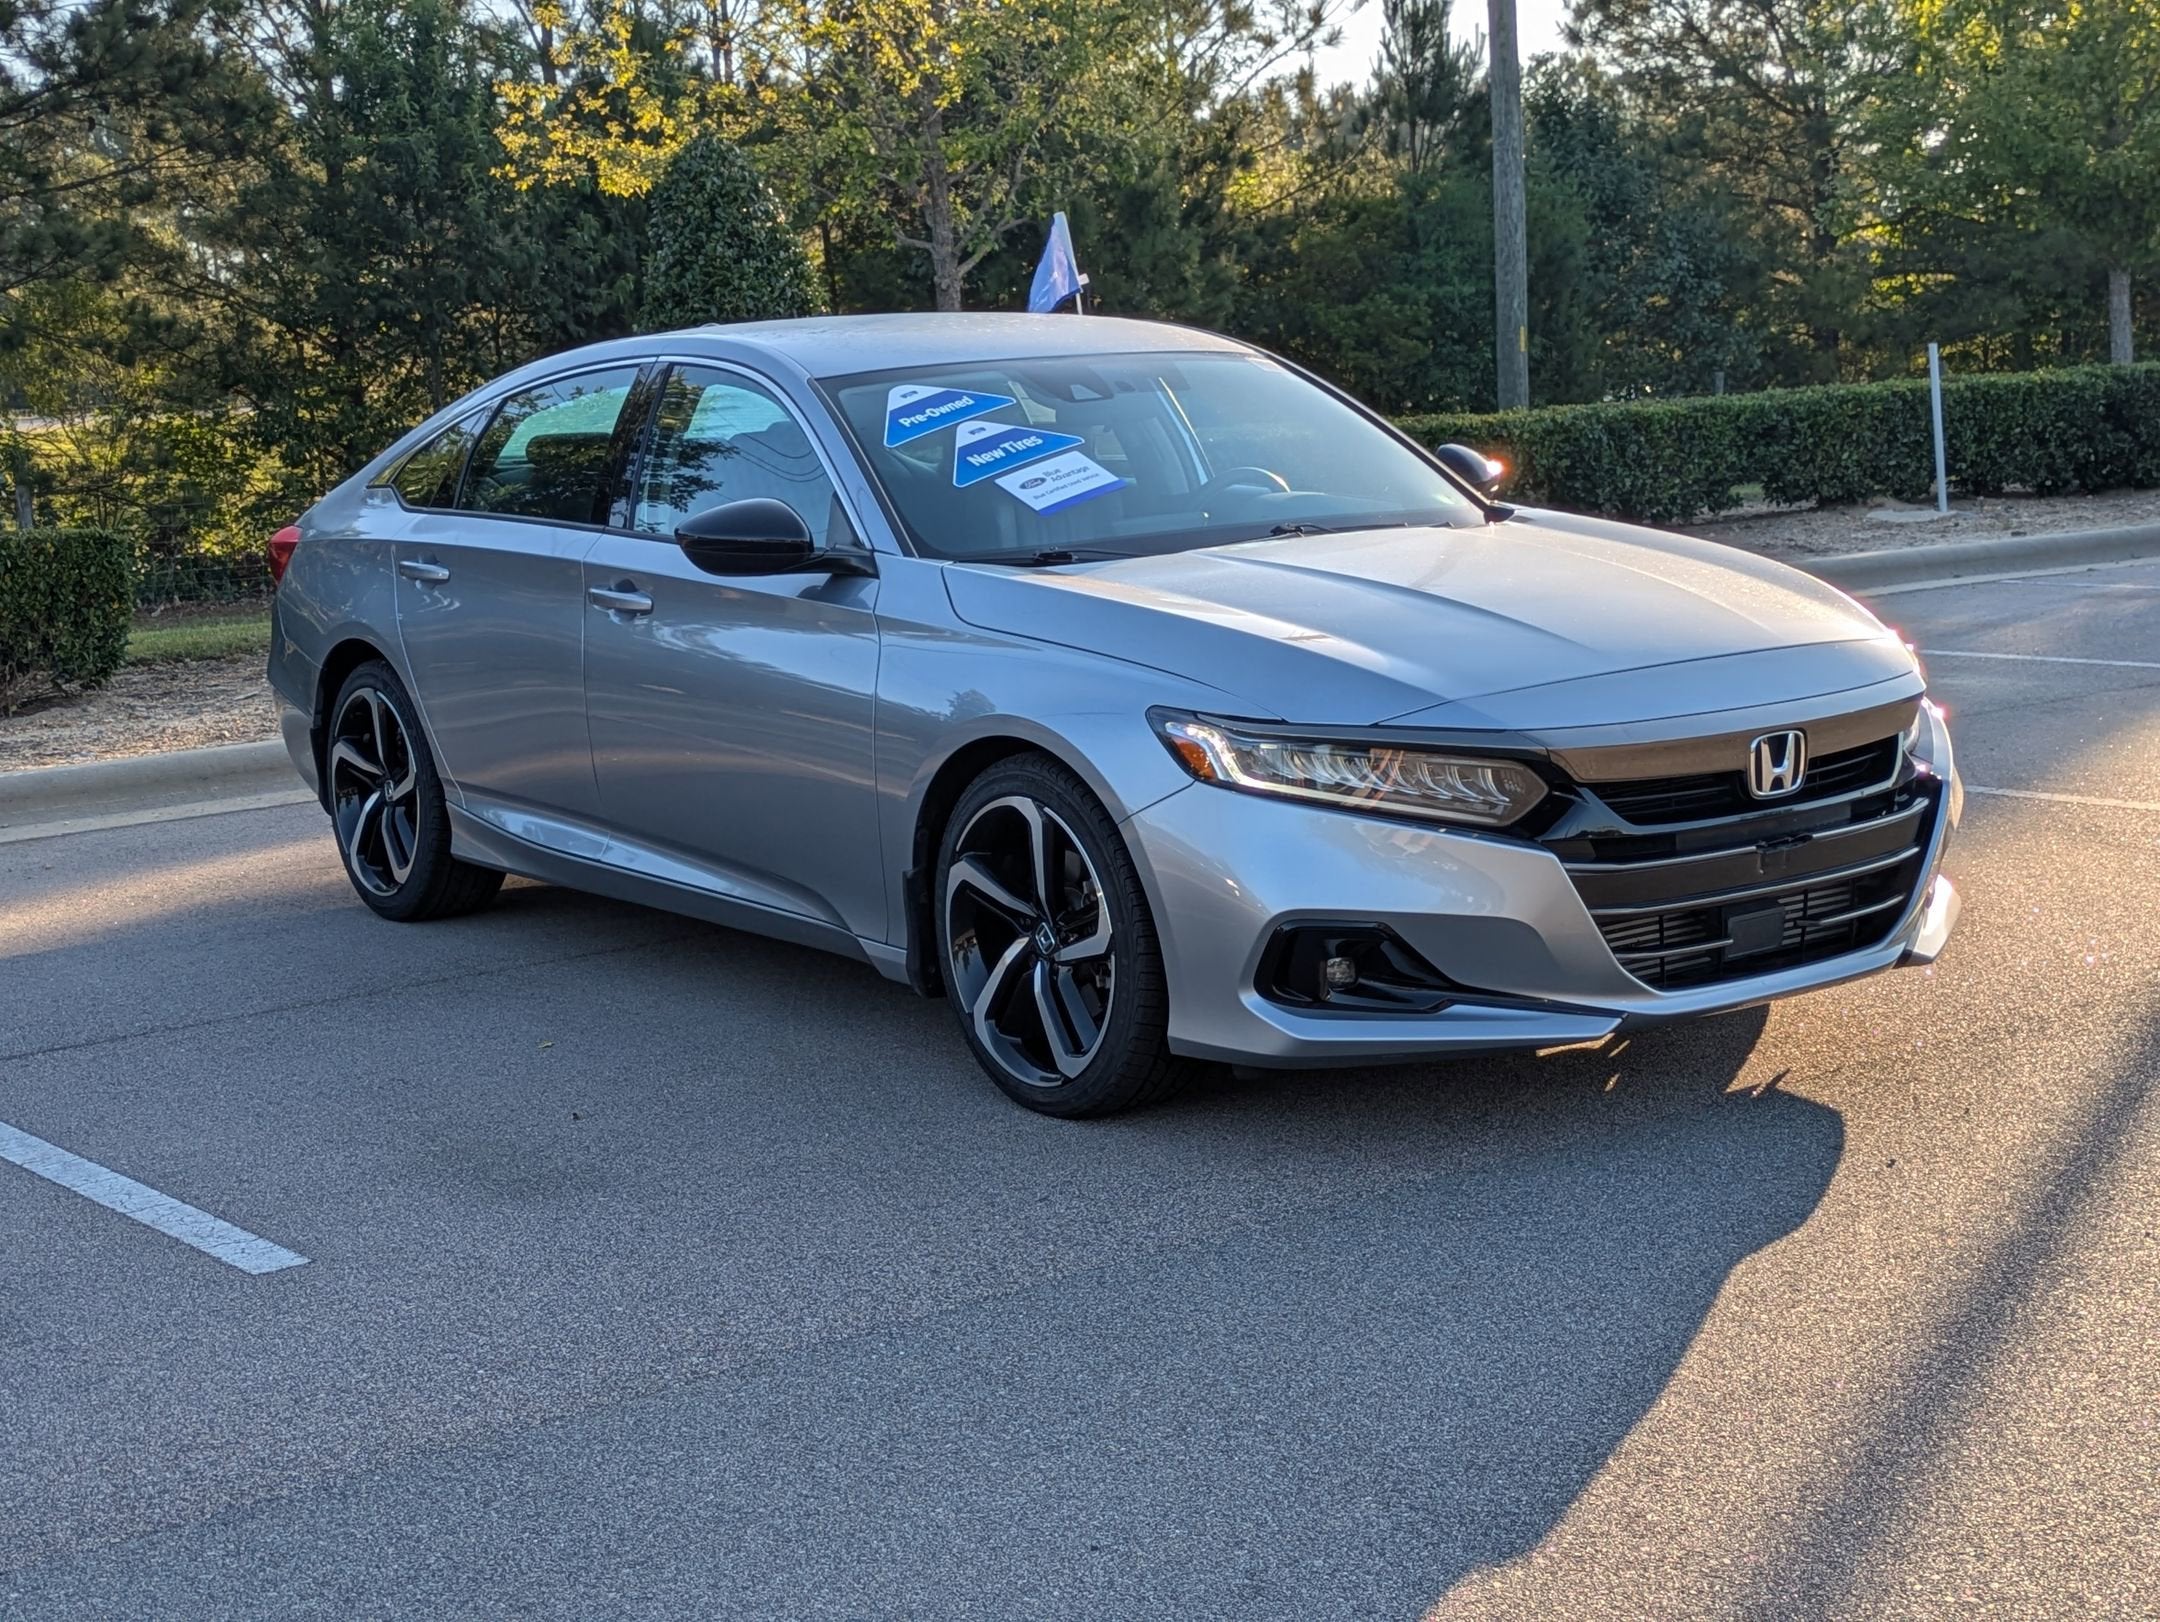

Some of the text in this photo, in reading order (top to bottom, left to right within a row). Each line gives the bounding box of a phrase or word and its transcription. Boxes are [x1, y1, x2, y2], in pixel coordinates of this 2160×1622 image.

[898, 395, 975, 428] Pre-Owned
[966, 435, 1044, 467] New Tires
